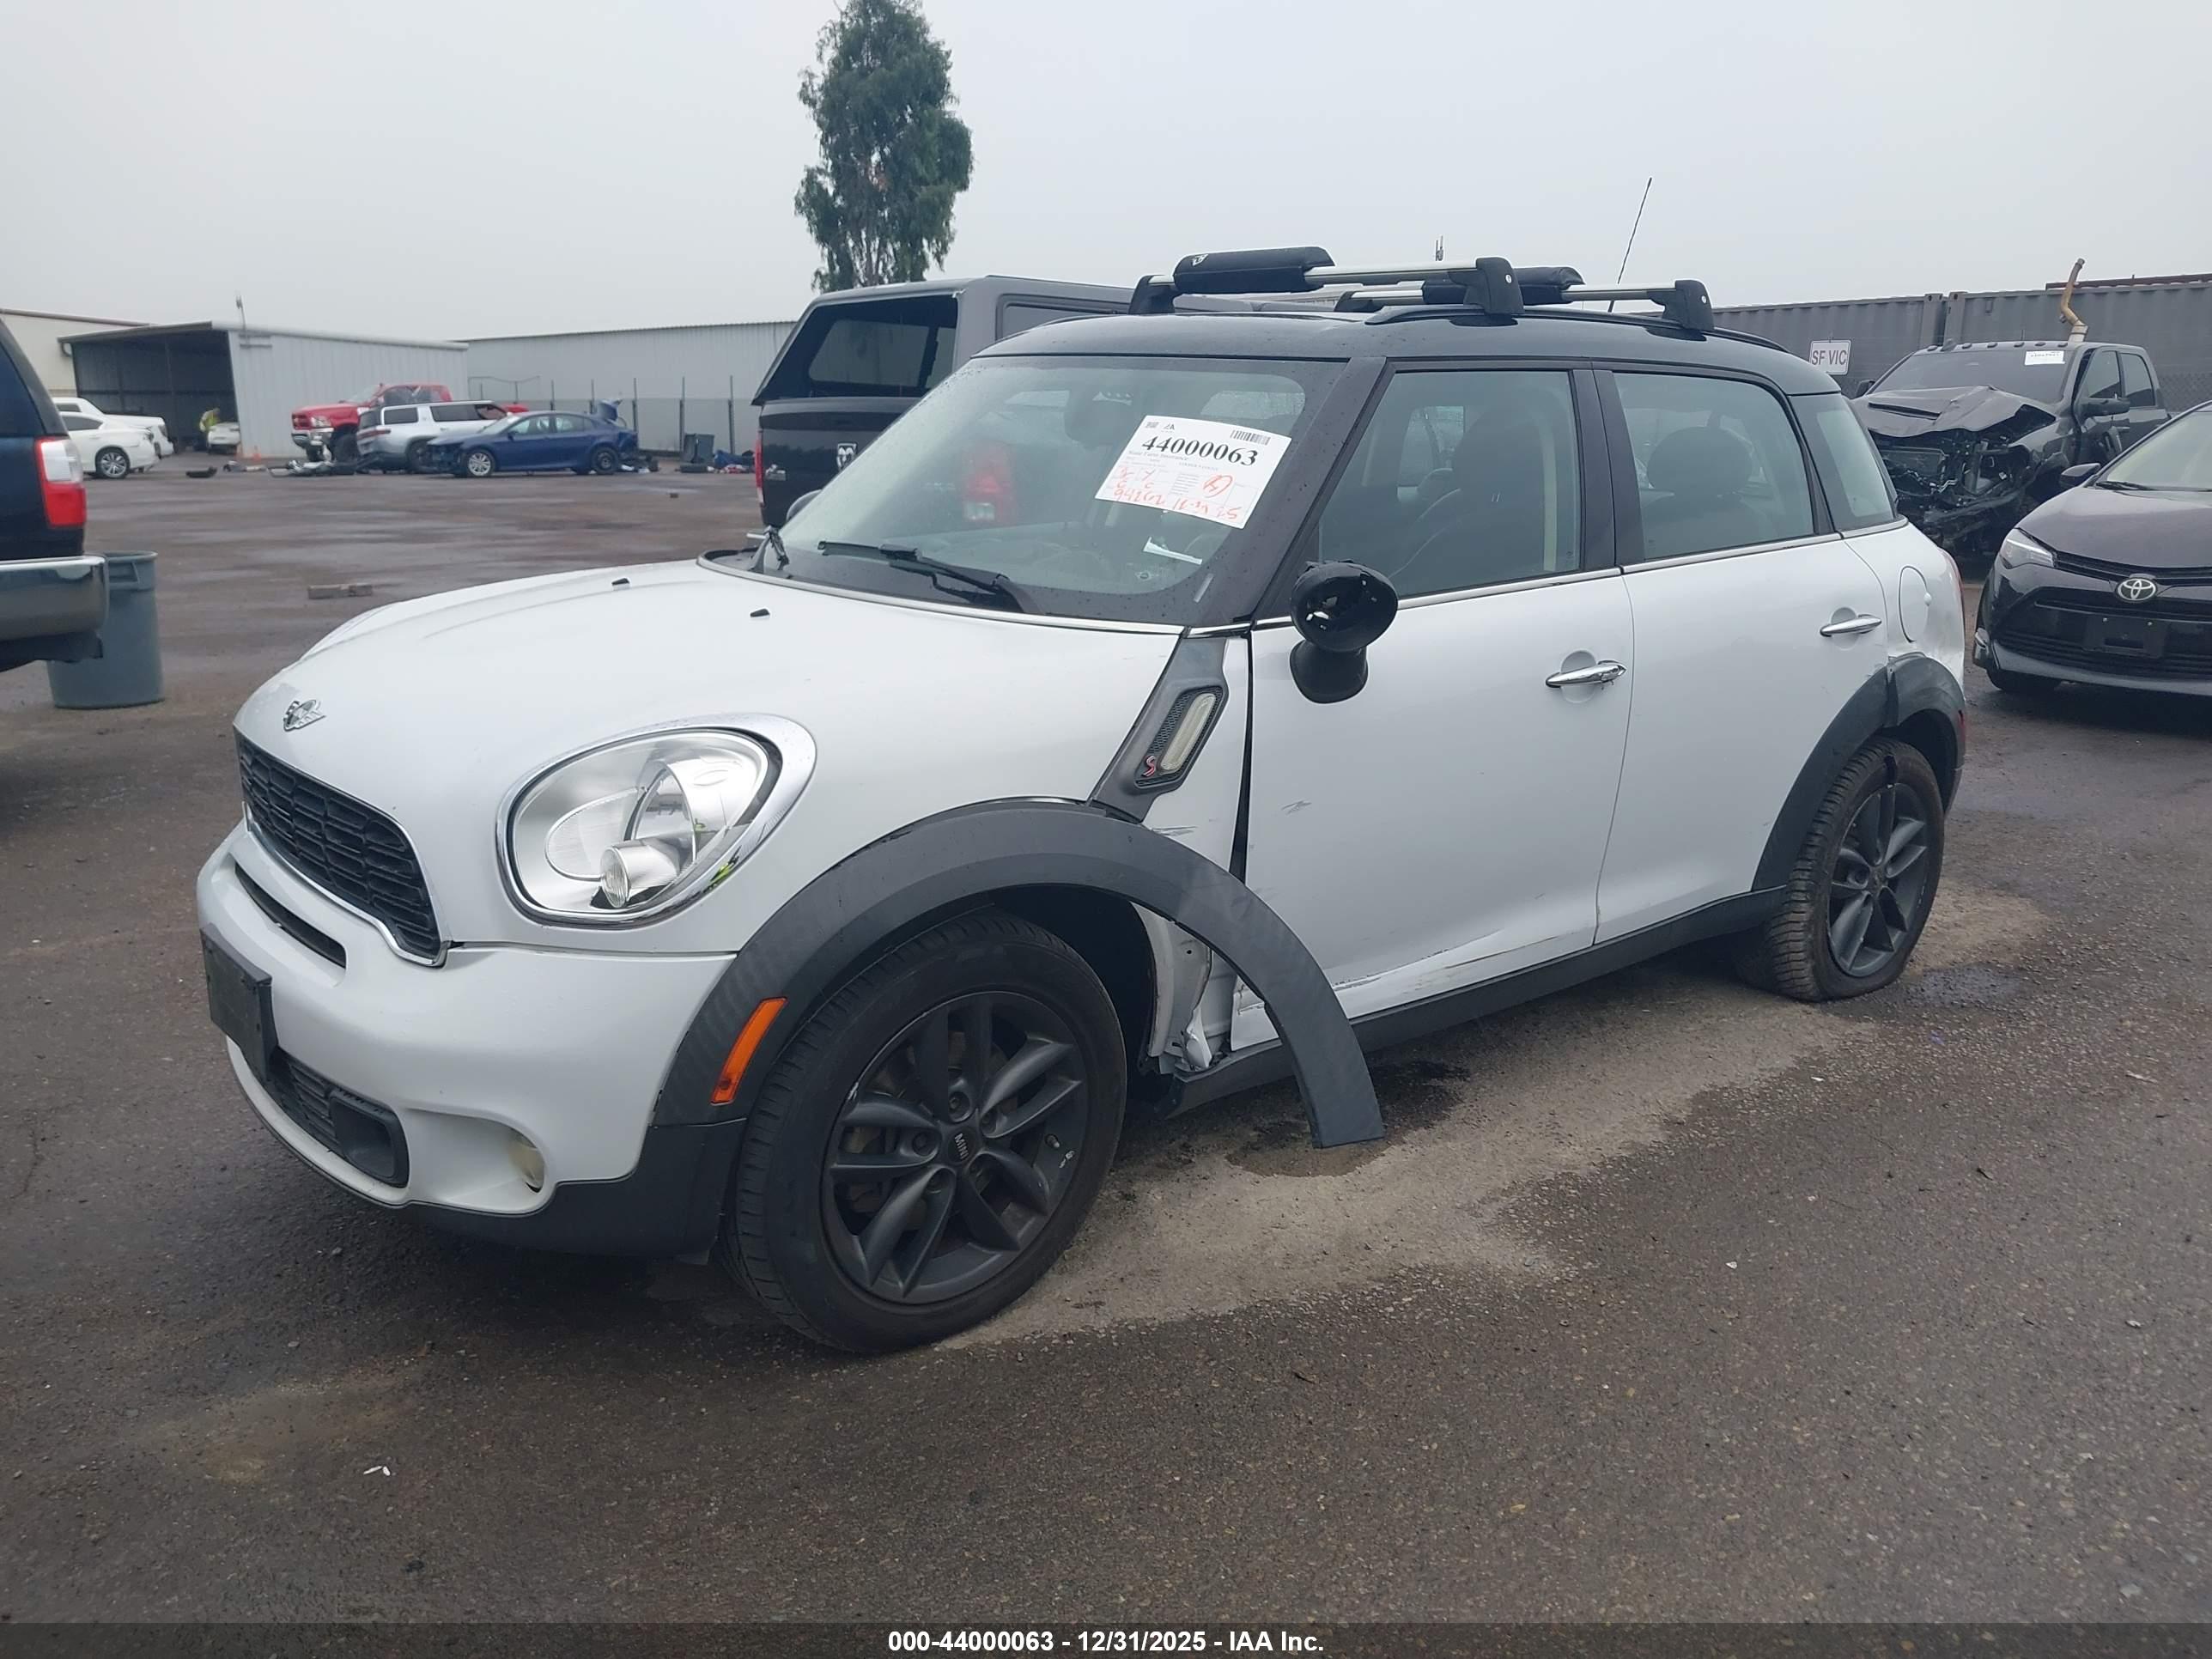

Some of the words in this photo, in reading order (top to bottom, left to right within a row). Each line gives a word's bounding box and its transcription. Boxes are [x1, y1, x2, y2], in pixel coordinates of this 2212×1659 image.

[1812, 349, 1826, 365] SF
[1828, 349, 1847, 365] VIC
[1141, 435, 1259, 466] 44000063
[1142, 755, 1156, 778] S
[954, 1133, 969, 1160] MINI
